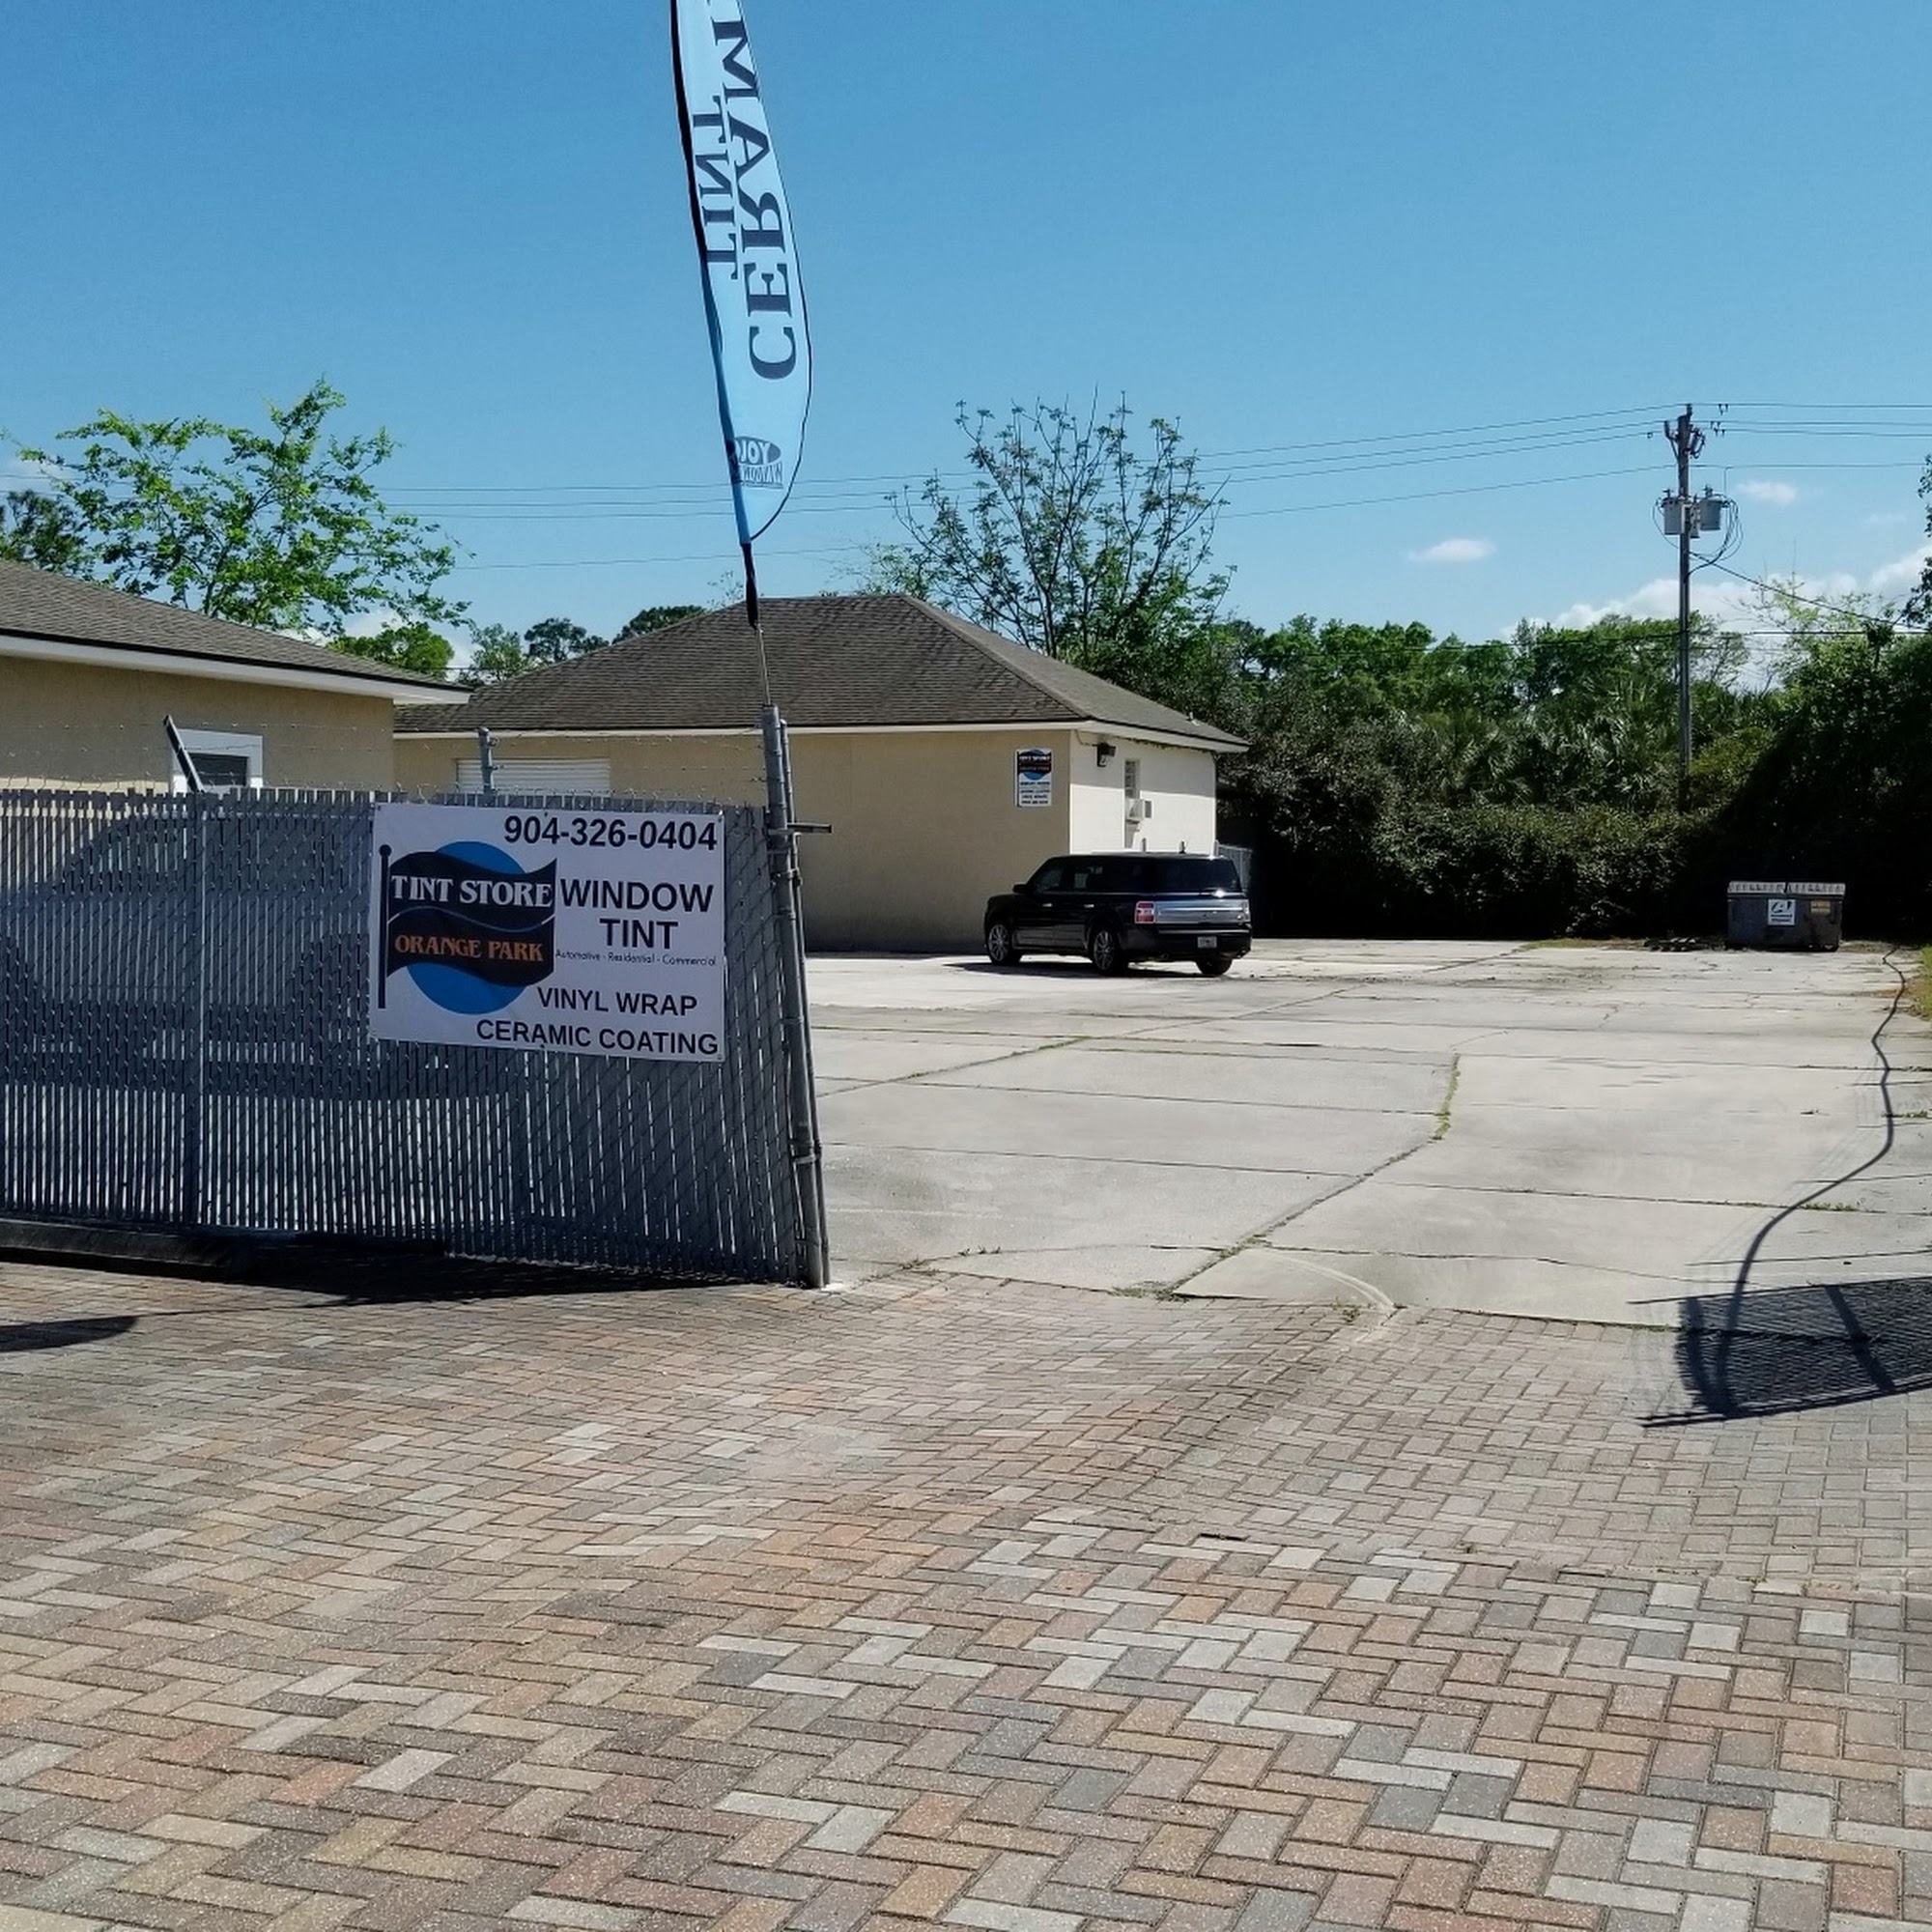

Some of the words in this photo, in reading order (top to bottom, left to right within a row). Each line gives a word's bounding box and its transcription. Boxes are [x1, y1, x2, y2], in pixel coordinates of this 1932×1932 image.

[503, 815, 718, 850] 904-326-0404
[391, 875, 453, 902] TINT
[459, 879, 553, 908] STORE
[560, 878, 714, 912] WINDOW
[394, 934, 481, 958] ORANGE
[488, 940, 544, 961] PARK
[599, 918, 678, 950] TINT
[554, 948, 601, 962] Automotive
[608, 951, 656, 964] Residential
[662, 953, 717, 966] Commercial
[537, 986, 609, 1012] VINYL
[615, 991, 697, 1016] WRAP
[476, 1019, 591, 1047] CERAMIC
[599, 1028, 719, 1055] COATING
